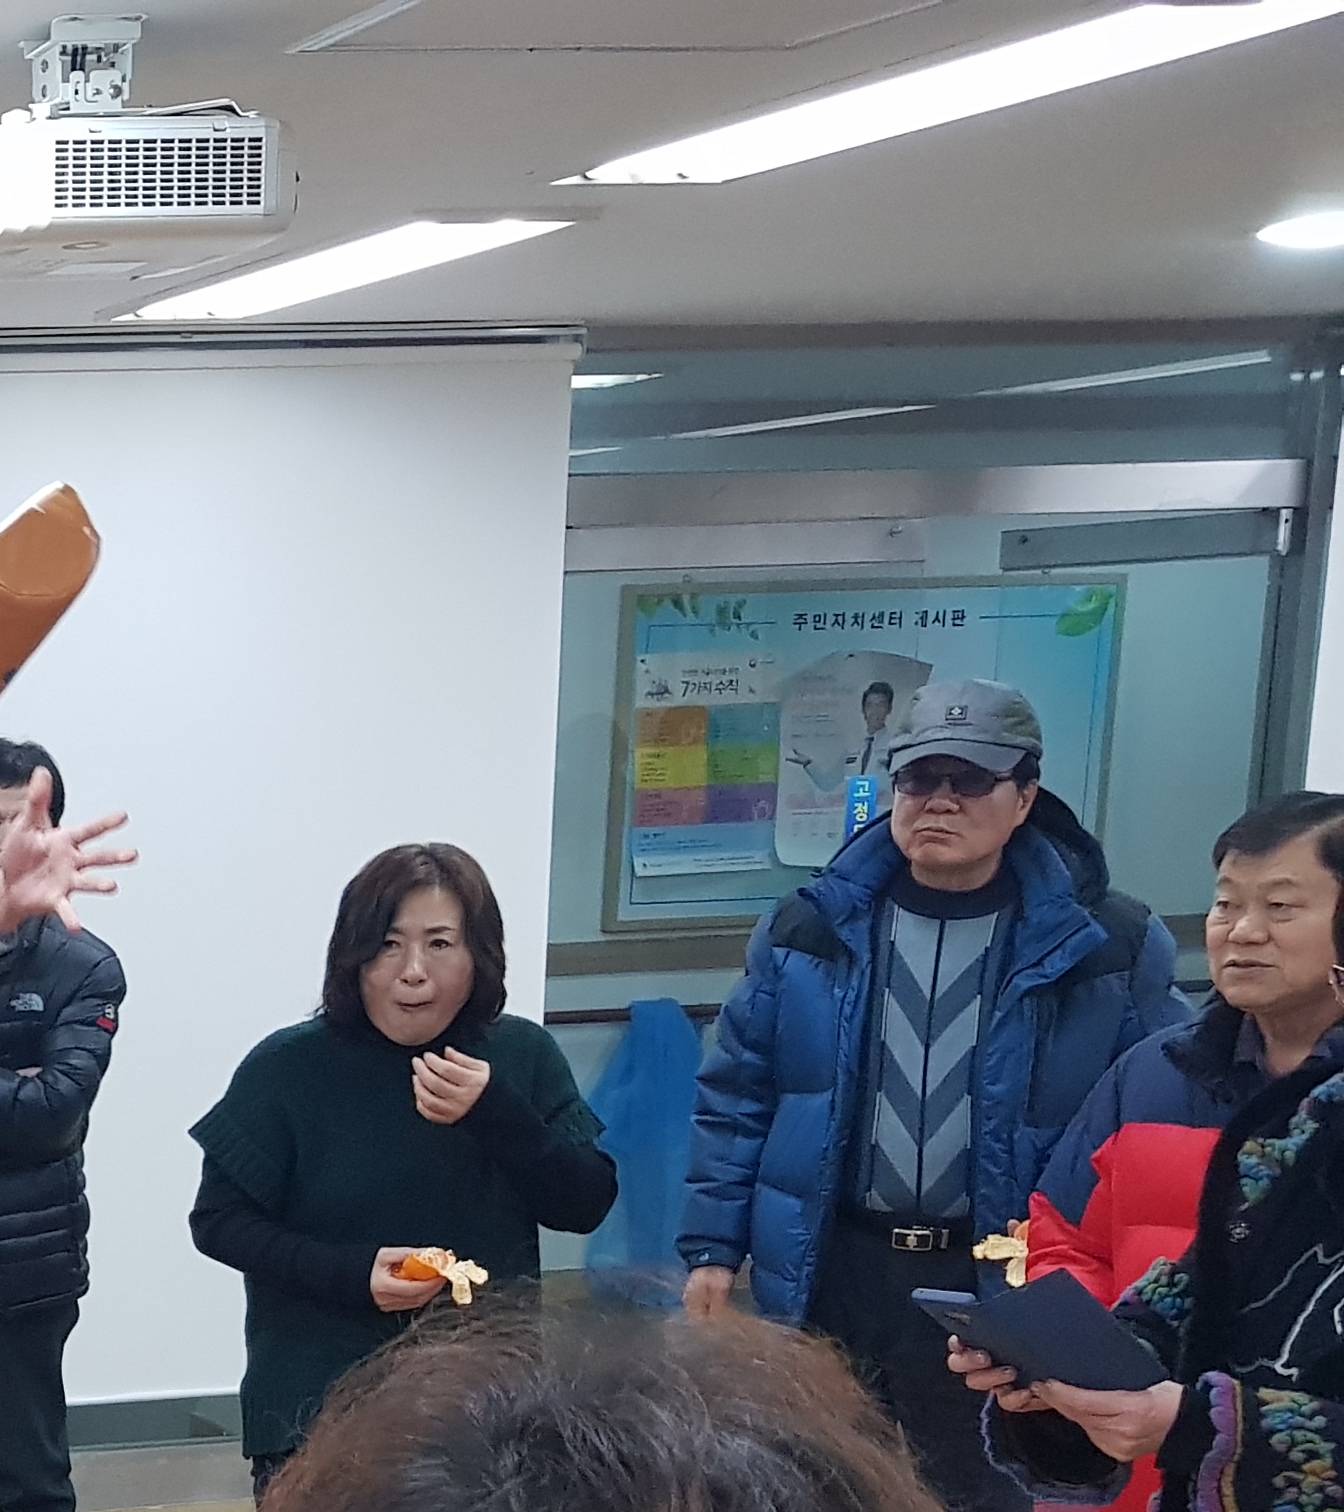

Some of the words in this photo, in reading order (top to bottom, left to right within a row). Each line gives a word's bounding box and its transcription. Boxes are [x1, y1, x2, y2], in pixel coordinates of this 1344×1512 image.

[792, 610, 904, 631] 주민자치센터
[914, 609, 967, 628] 게시판
[680, 681, 712, 697] 7가지
